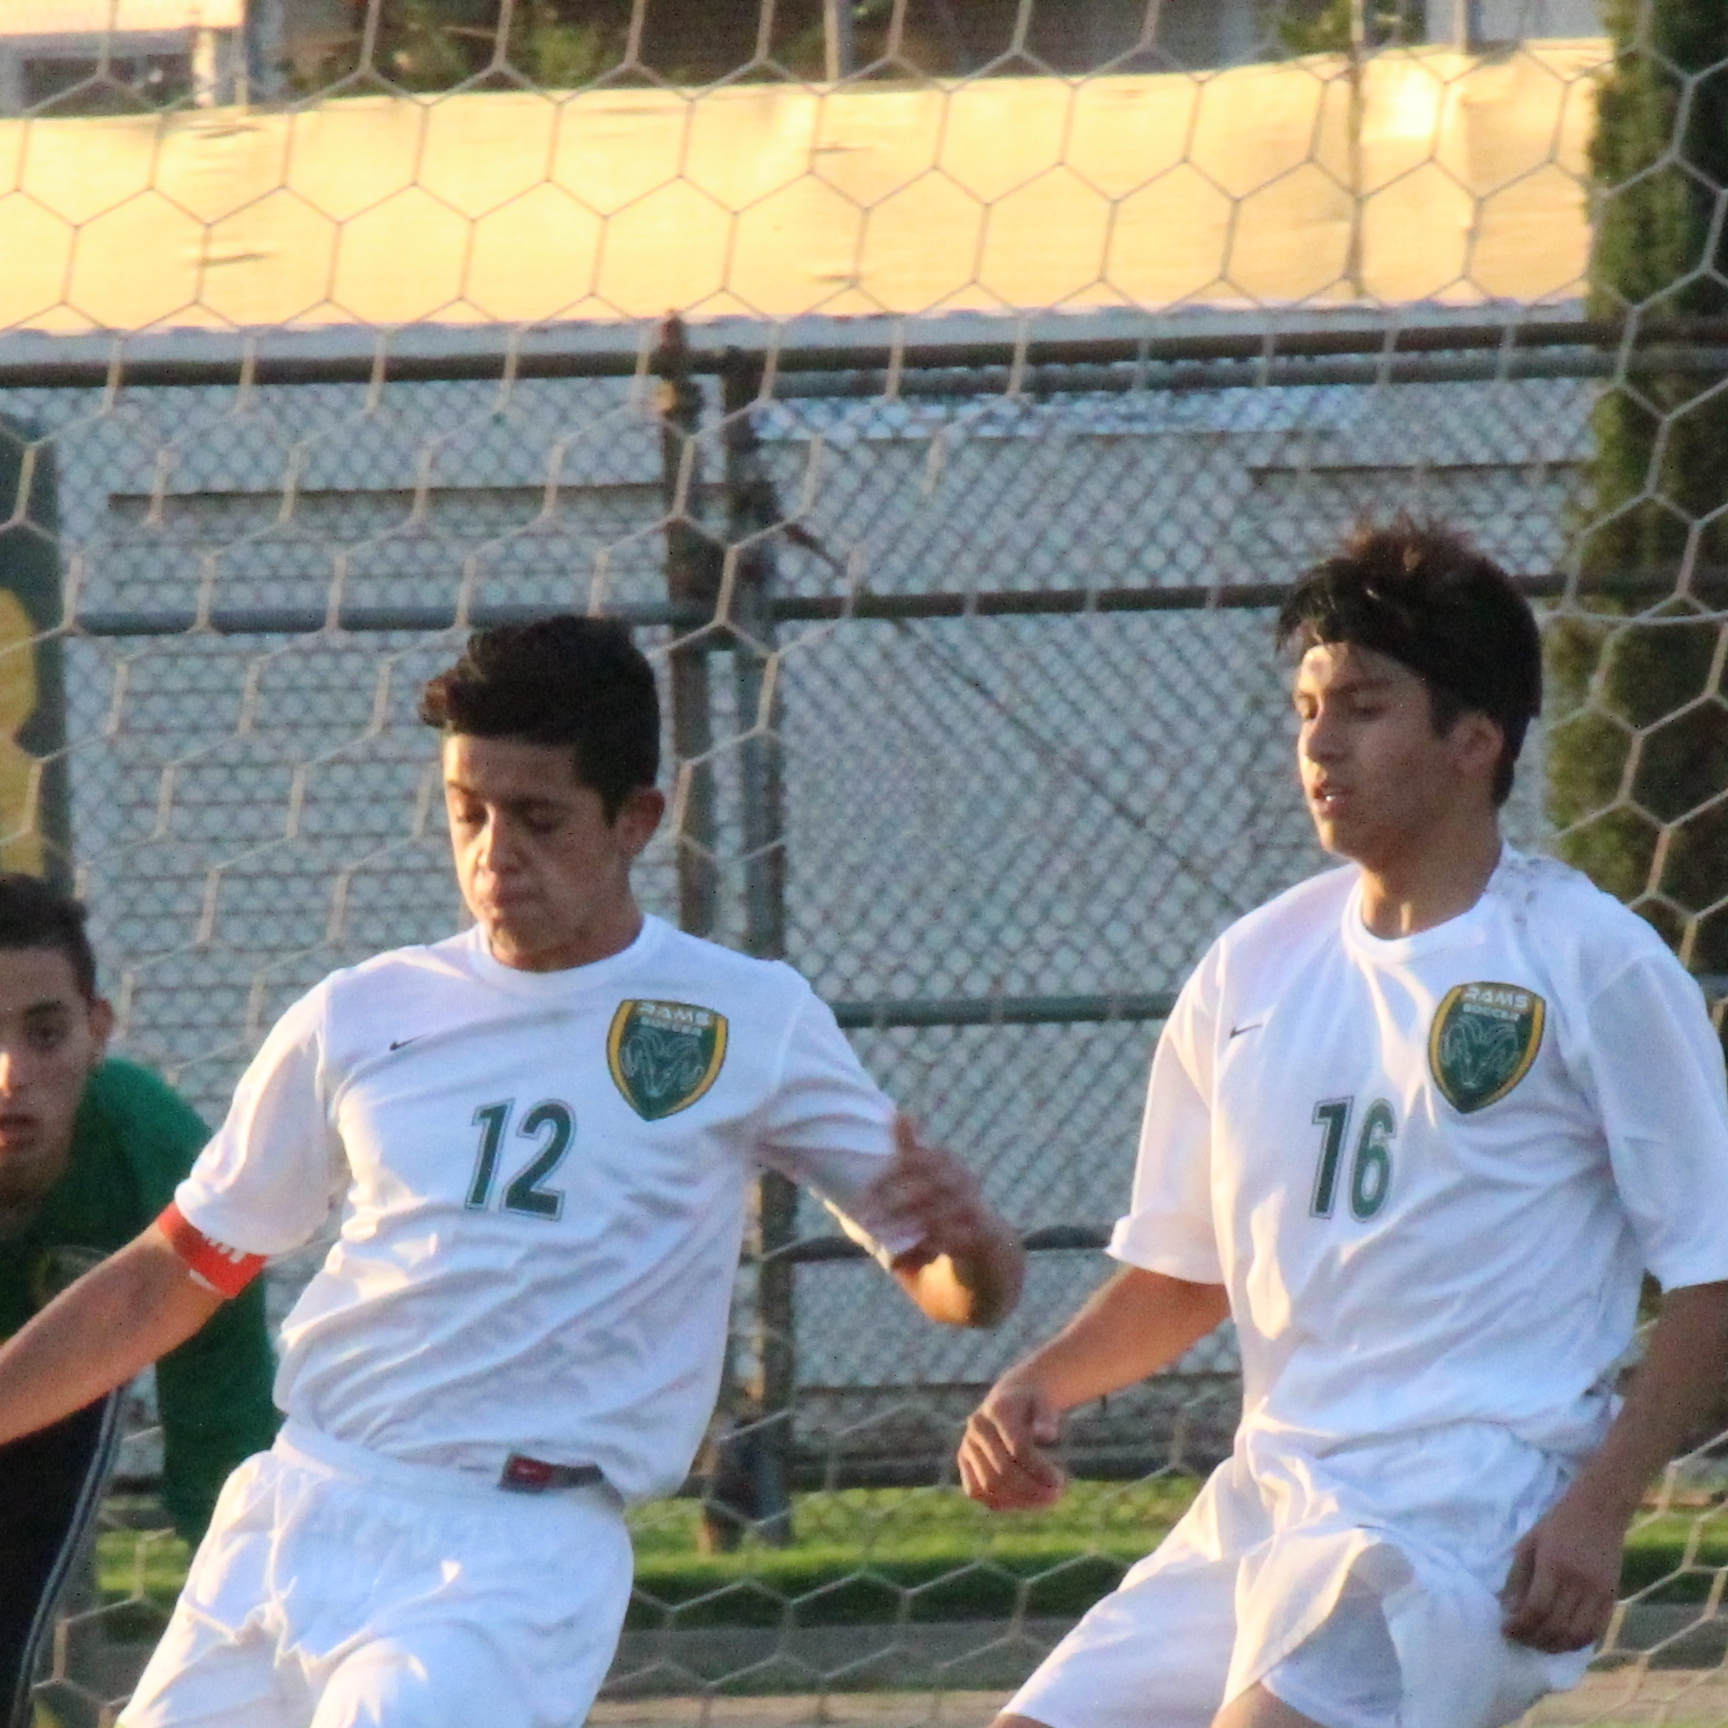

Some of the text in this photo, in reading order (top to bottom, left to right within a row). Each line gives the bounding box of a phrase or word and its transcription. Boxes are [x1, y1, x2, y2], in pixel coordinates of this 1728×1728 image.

[1462, 986, 1529, 1009] RAMS
[464, 1097, 578, 1222] 12
[1309, 1095, 1398, 1224] 16
